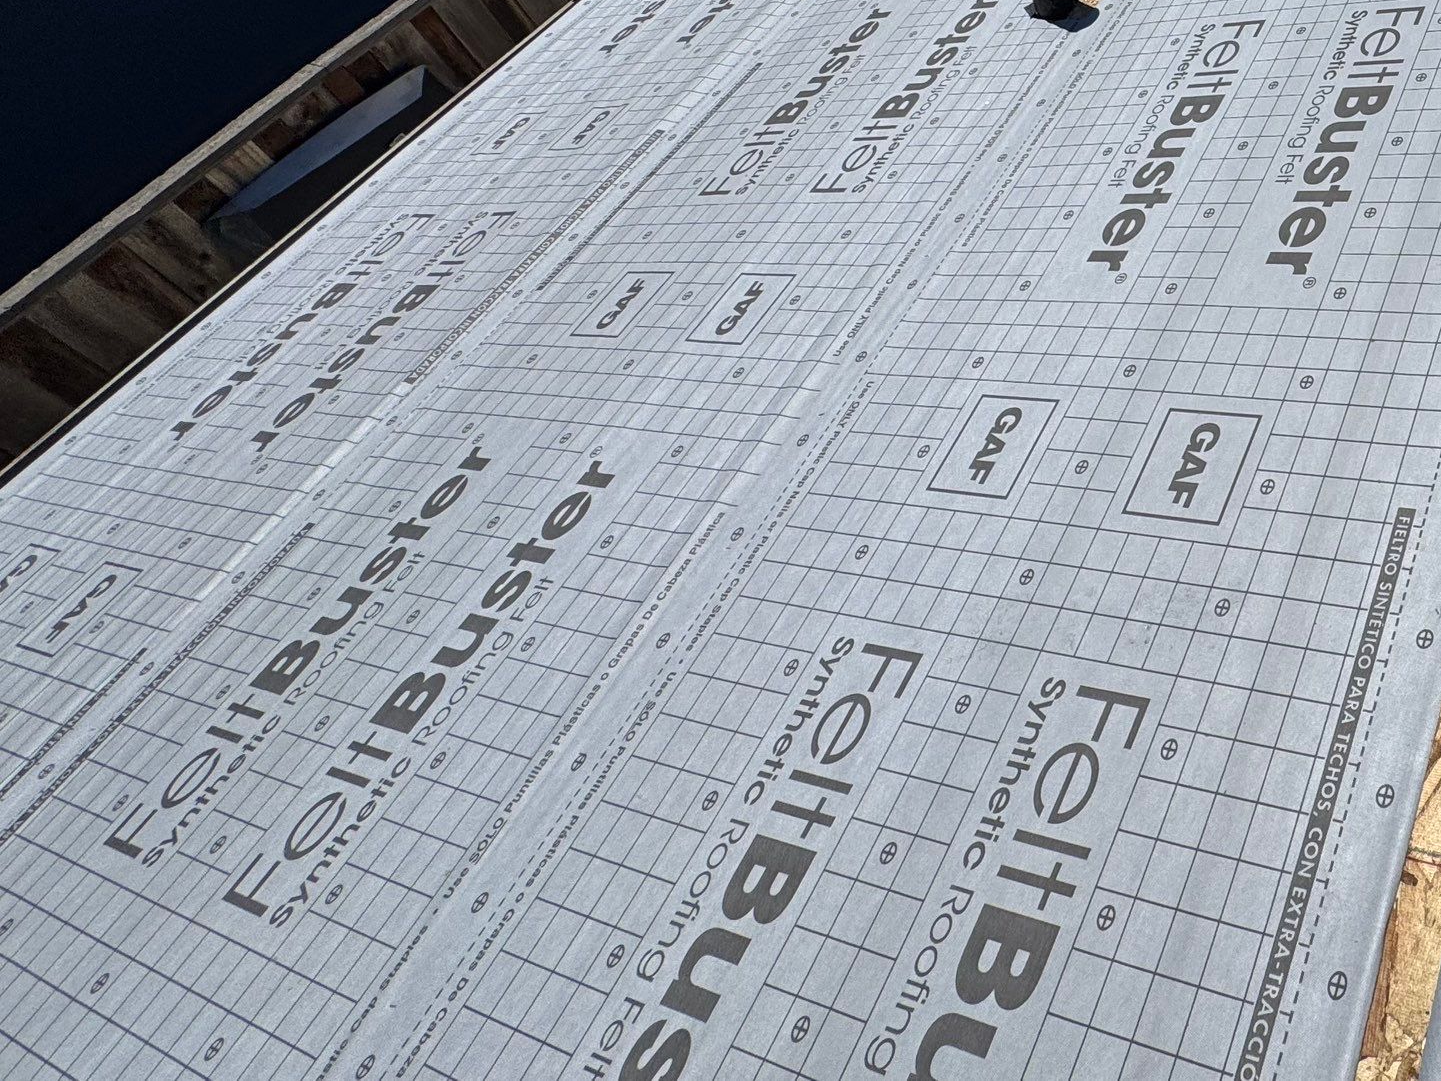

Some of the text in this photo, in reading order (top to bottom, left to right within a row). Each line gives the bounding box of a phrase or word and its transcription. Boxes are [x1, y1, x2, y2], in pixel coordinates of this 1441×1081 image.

[571, 108, 612, 147] GAF
[850, 44, 978, 194] Synthetic Roofing Felt
[1107, 22, 1217, 189] Synthetic Roofing Felt
[1273, 9, 1369, 186] Synthetic Roofing Felt
[491, 116, 531, 151] GAF
[734, 76, 849, 196] Synthetic Roofing
[596, 277, 647, 331] GAF
[714, 280, 767, 336] GAF
[830, 404, 858, 440] ONLY
[854, 381, 873, 406] Use
[805, 437, 836, 480] Plastic
[968, 406, 1024, 486] GAF
[1165, 422, 1224, 510] GAF
[764, 501, 791, 536] Nails
[787, 477, 808, 504] Cap
[728, 547, 760, 590] Plastic
[1384, 516, 1411, 576] FIELTRO
[44, 572, 120, 644] GAF
[710, 588, 732, 616] Cap
[1357, 581, 1393, 671] SINTÉTICO
[679, 617, 713, 663] Staples
[142, 548, 429, 870] Synthetic Roofing Felt
[654, 675, 675, 703] Use
[1341, 675, 1366, 725] PARA
[270, 572, 557, 930] Synthetic Roofing Felt
[346, 511, 723, 1037] Cap Staples Use Puntillas Plásticas Grapas De Cabeza Plástica
[1311, 730, 1351, 818] TECHOS,
[566, 751, 624, 824] Puntillas
[633, 635, 856, 987] Synthetic Roofing
[863, 675, 1067, 1075] Synthetic Roofing
[1298, 827, 1323, 879] CON
[456, 920, 508, 985] Grapas
[392, 1014, 444, 1080] Cabeza
